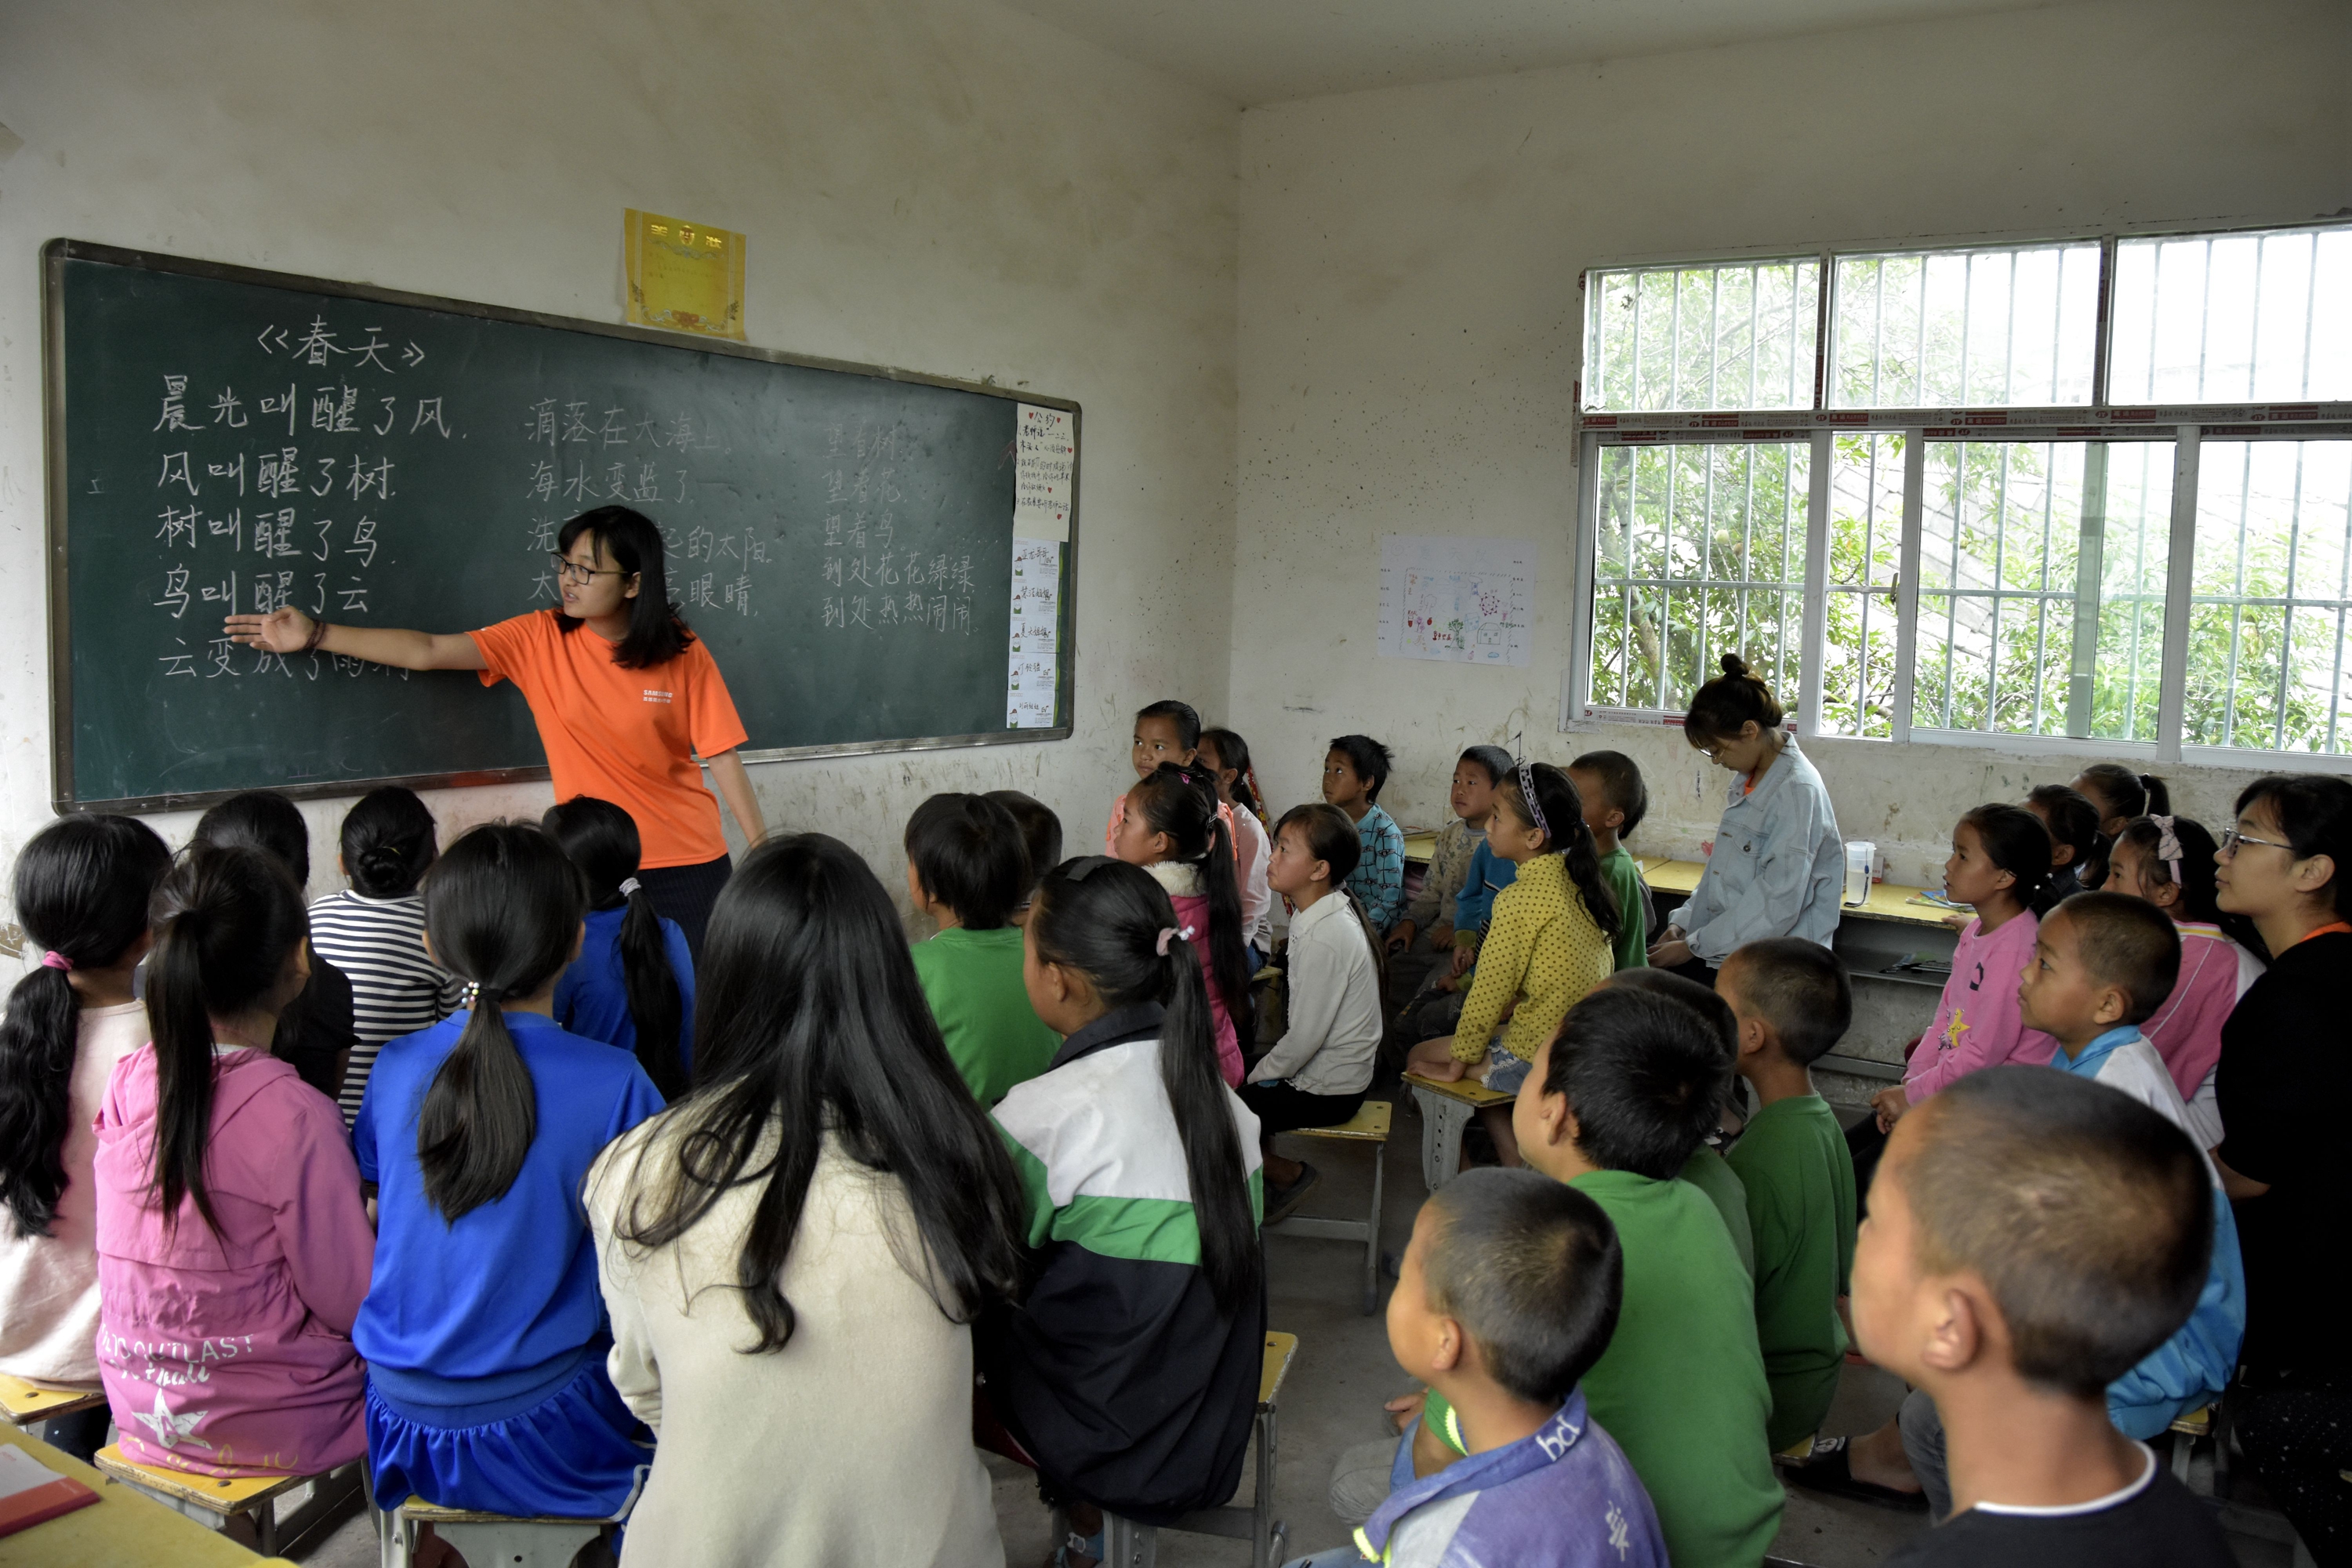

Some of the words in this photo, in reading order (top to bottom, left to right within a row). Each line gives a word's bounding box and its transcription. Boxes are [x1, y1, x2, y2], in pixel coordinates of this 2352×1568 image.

[256, 314, 425, 373] 《春天》
[154, 563, 369, 619] 鸟叫醒了云
[644, 689, 673, 698] SAMSUNG
